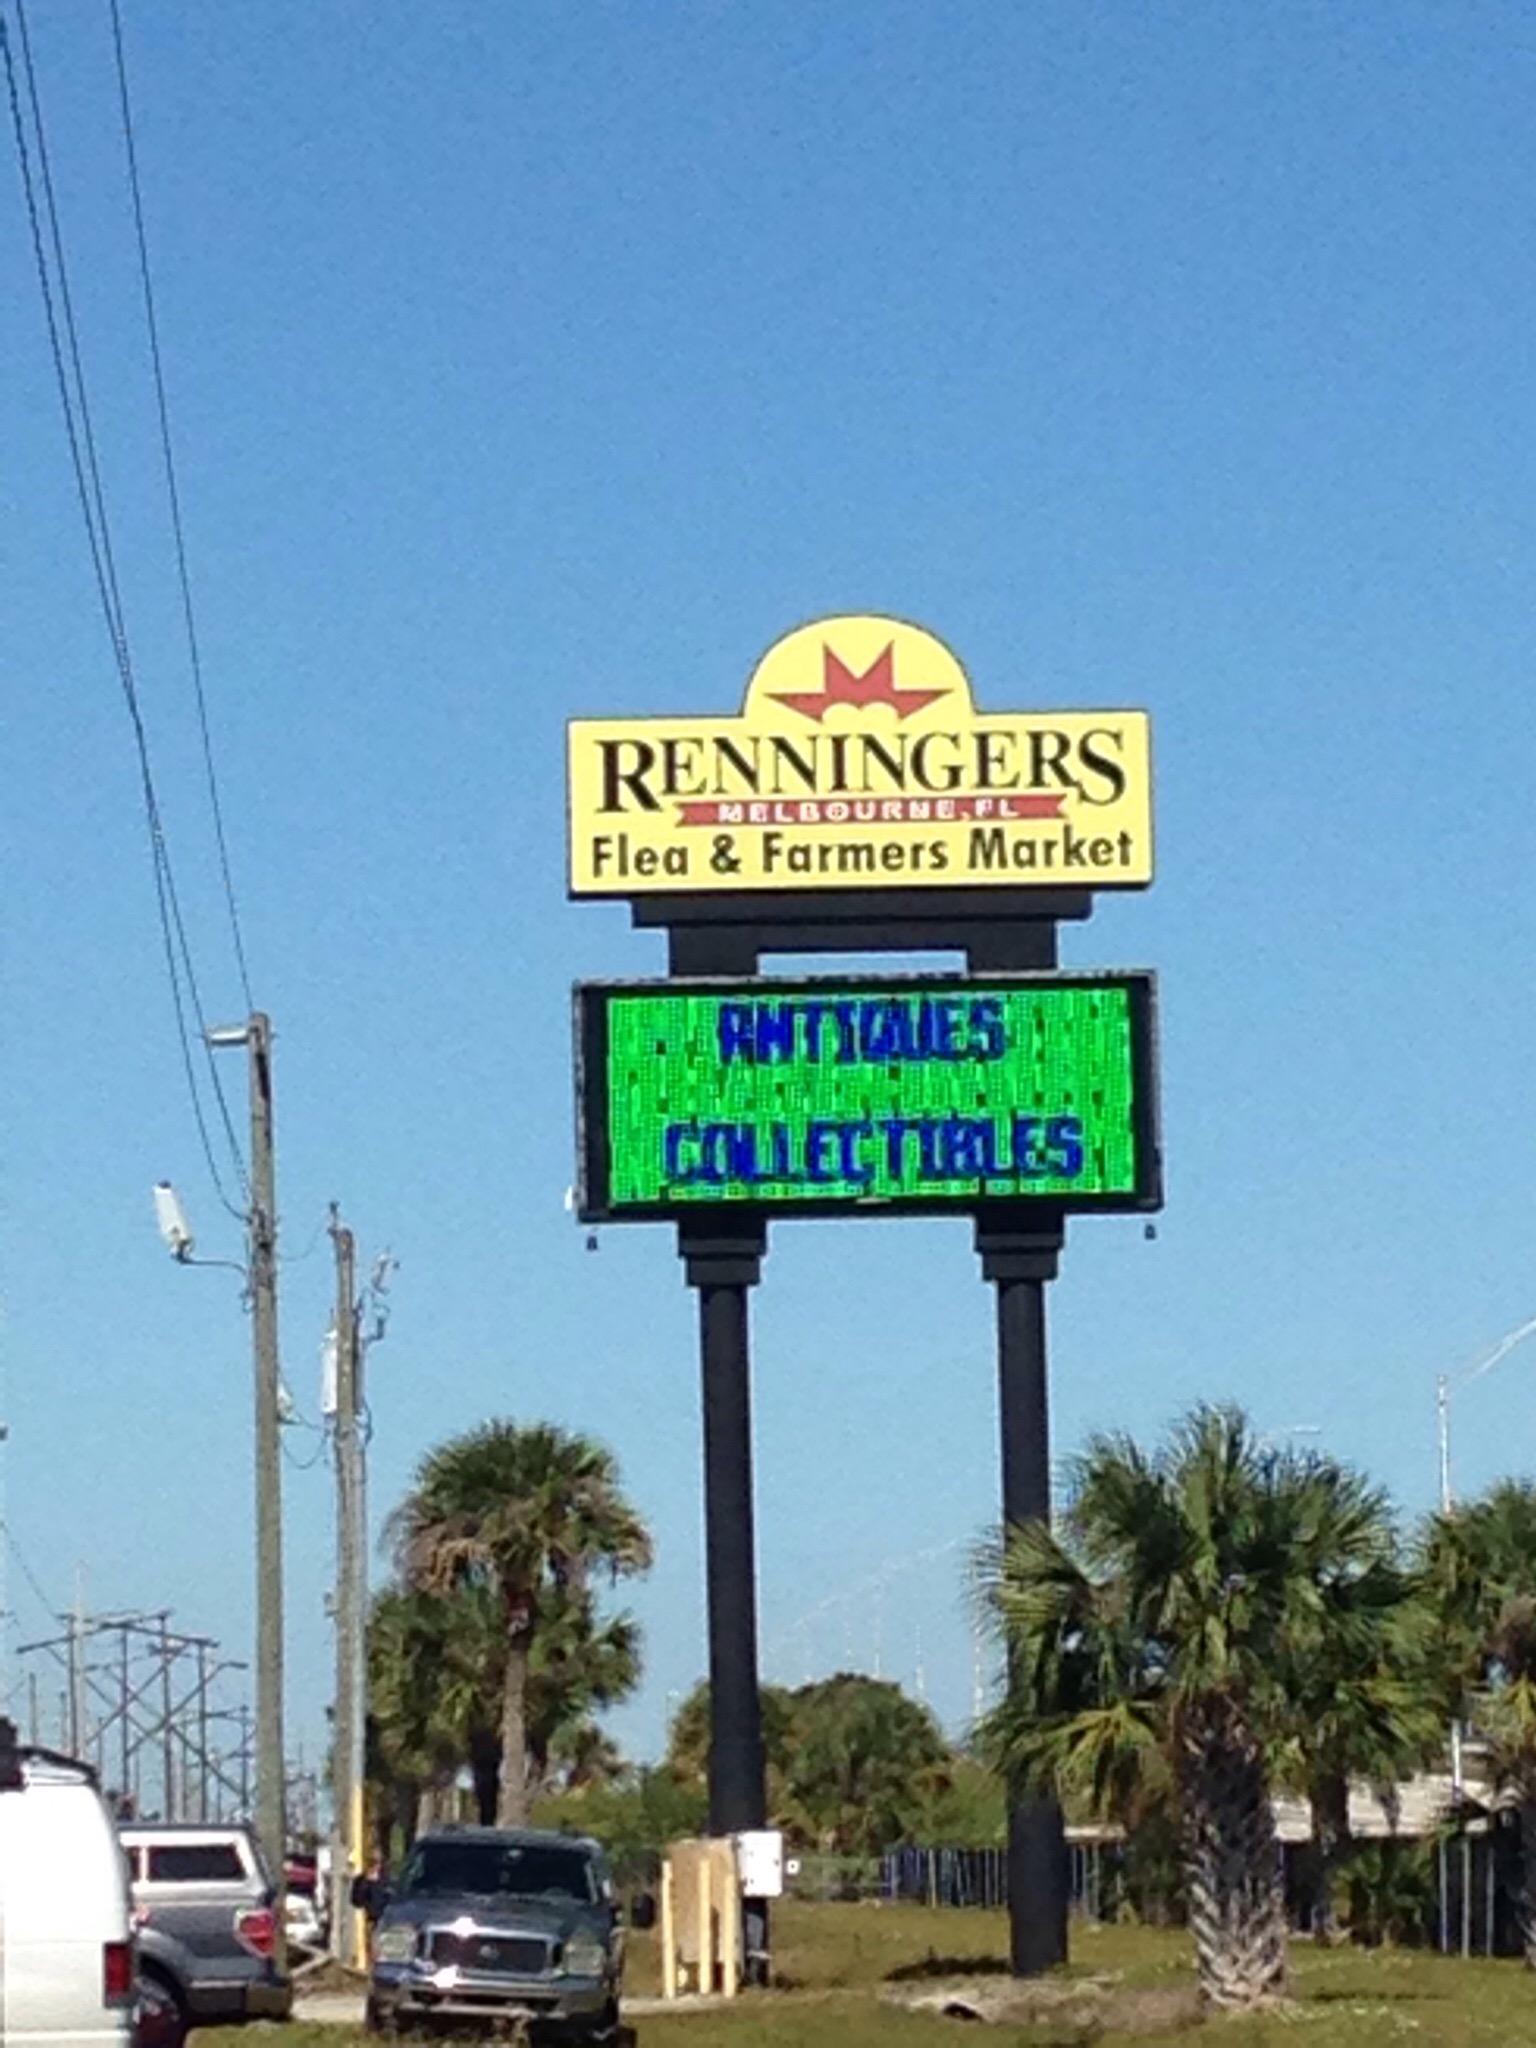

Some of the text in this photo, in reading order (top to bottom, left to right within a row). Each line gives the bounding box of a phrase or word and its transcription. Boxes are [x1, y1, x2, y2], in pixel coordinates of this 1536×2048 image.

[594, 728, 1127, 814] RENNINGERS
[592, 827, 1133, 878] Flea & Farmers Market
[718, 1000, 1008, 1064] ANTIQUES
[664, 1117, 1085, 1183] COLLECTIBLES
